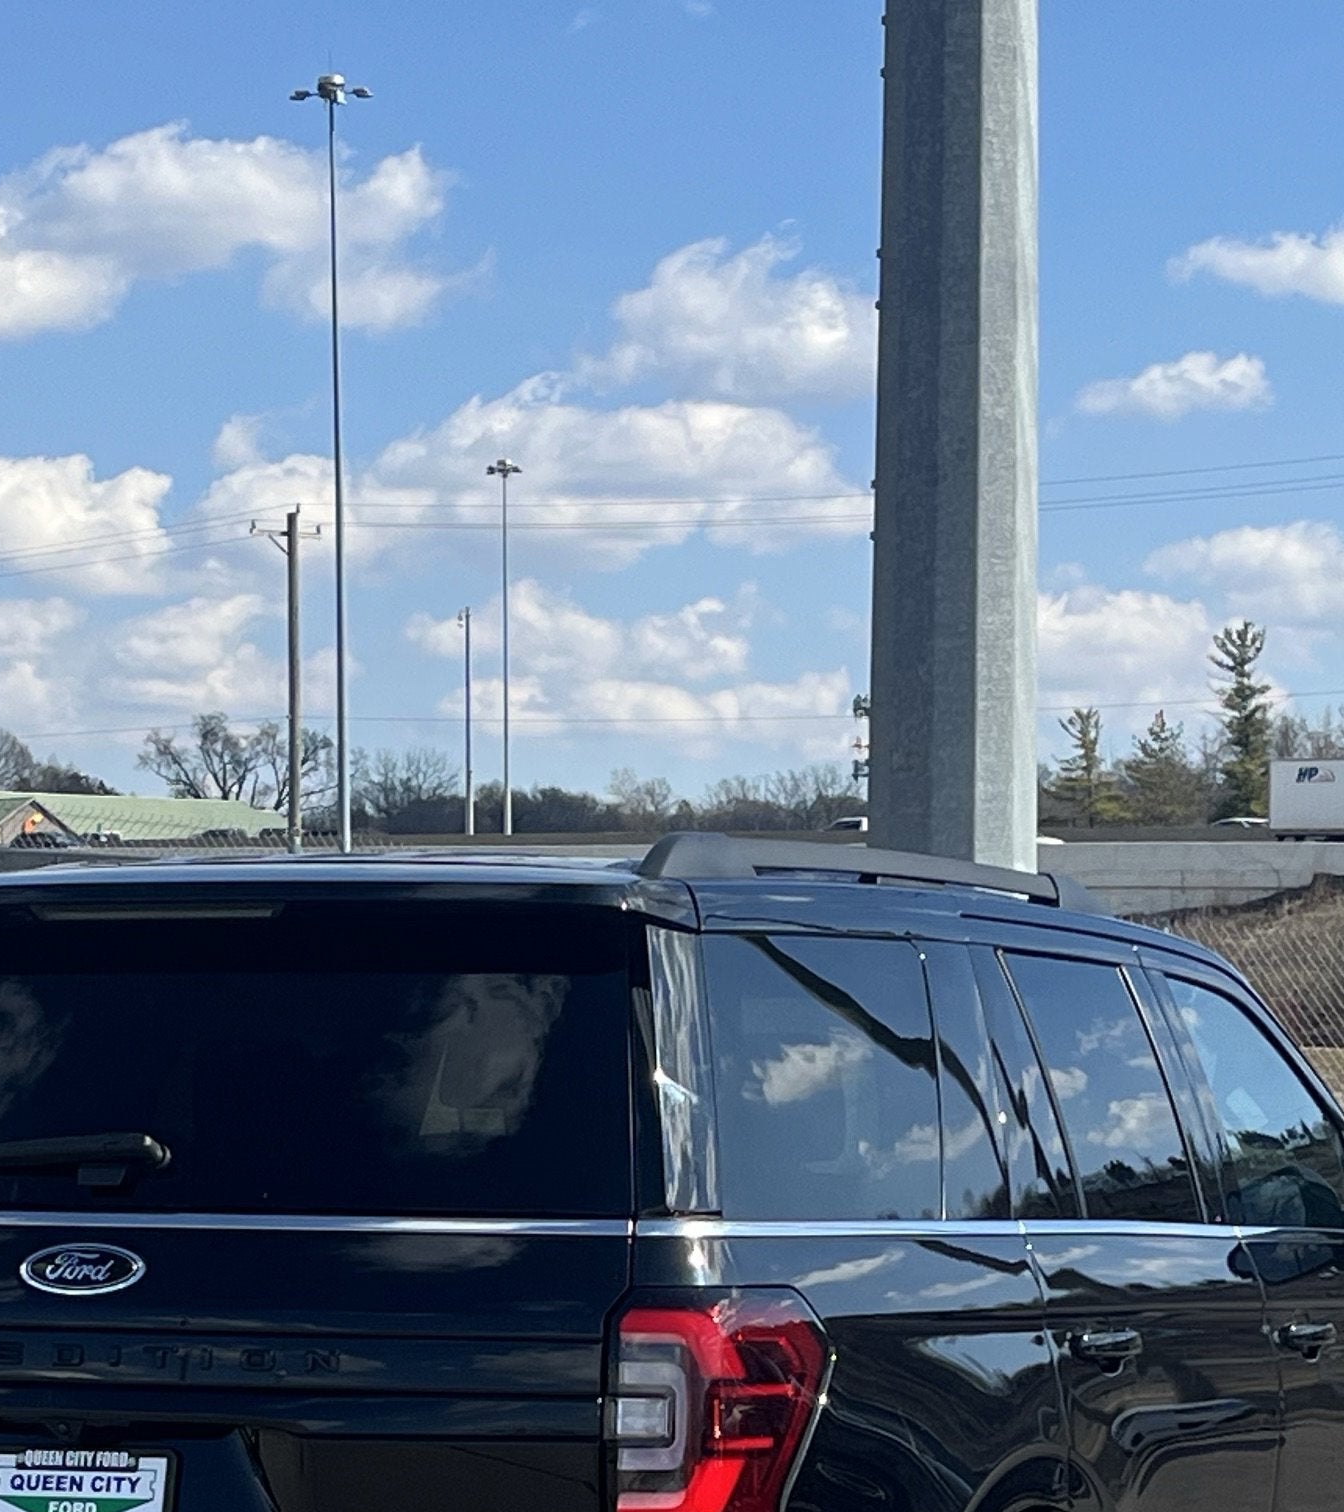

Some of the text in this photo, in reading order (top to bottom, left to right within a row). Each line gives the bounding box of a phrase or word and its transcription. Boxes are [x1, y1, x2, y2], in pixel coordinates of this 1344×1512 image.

[46, 1252, 115, 1280] Ford
[25, 1449, 129, 1468] QUEEN CITY FORD
[10, 1474, 141, 1493] QUEEN CITY
